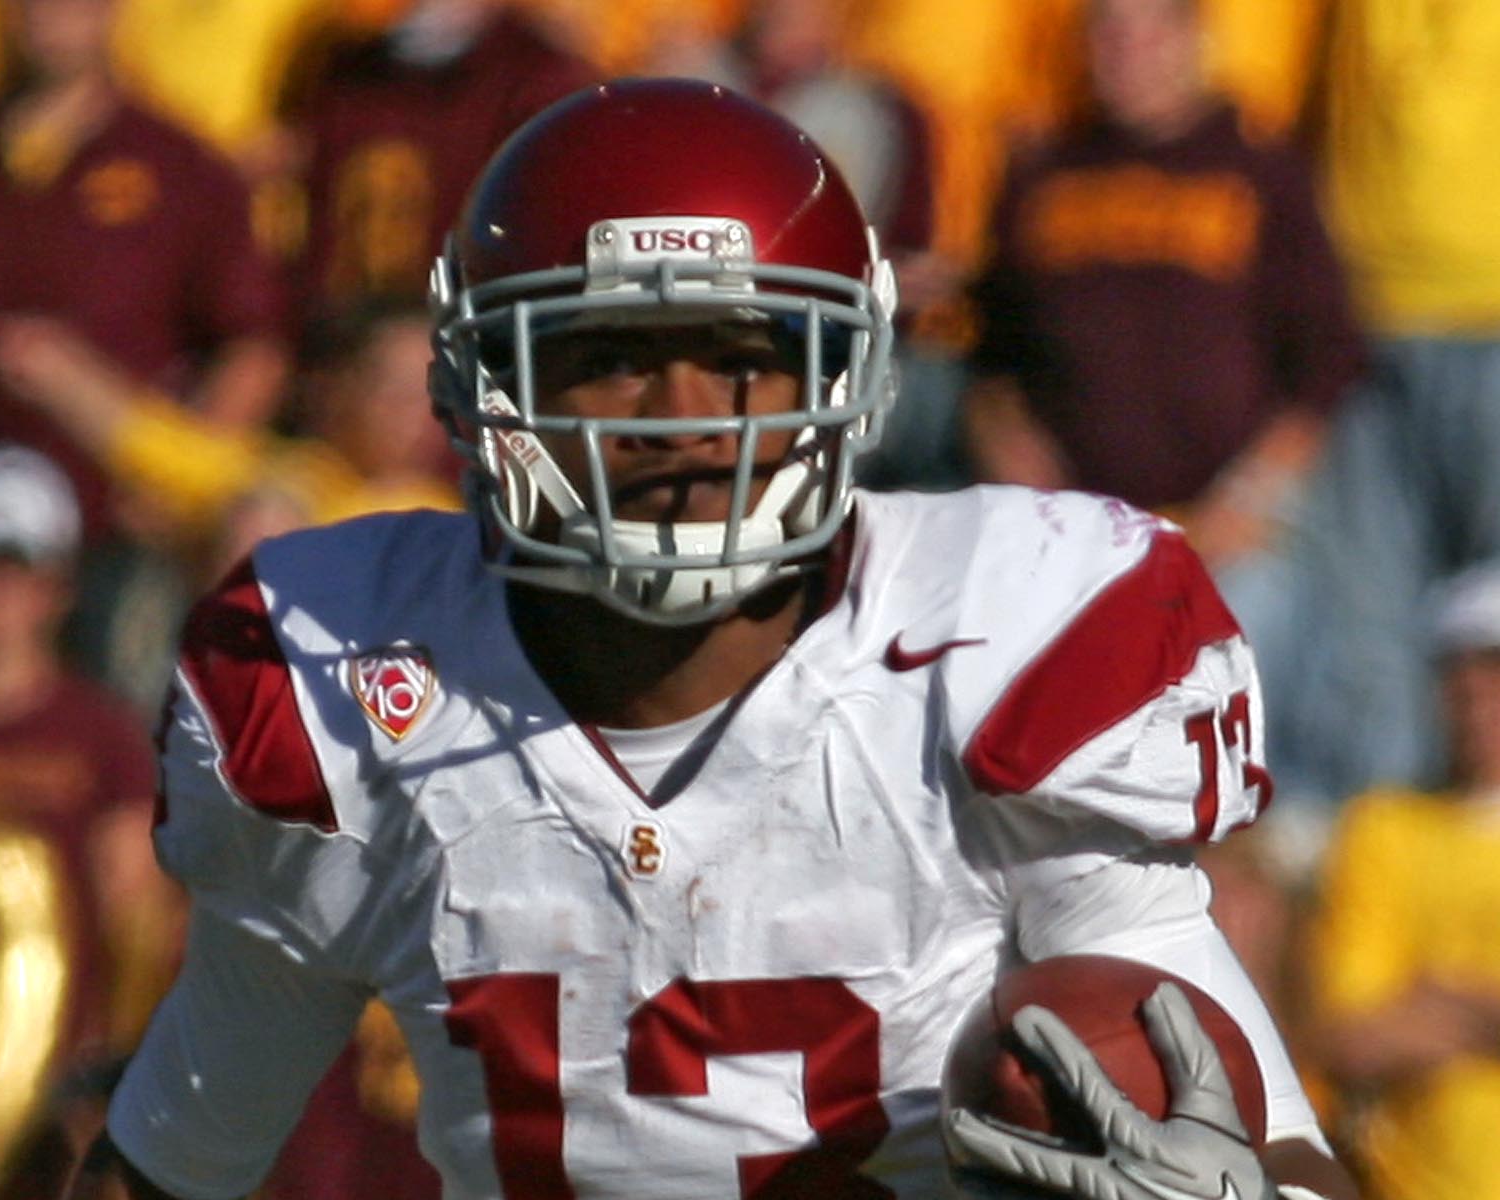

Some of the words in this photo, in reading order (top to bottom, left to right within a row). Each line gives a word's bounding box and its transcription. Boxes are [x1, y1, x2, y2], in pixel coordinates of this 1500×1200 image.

[631, 229, 714, 252] USC
[378, 682, 418, 720] 10
[1184, 690, 1274, 842] 13
